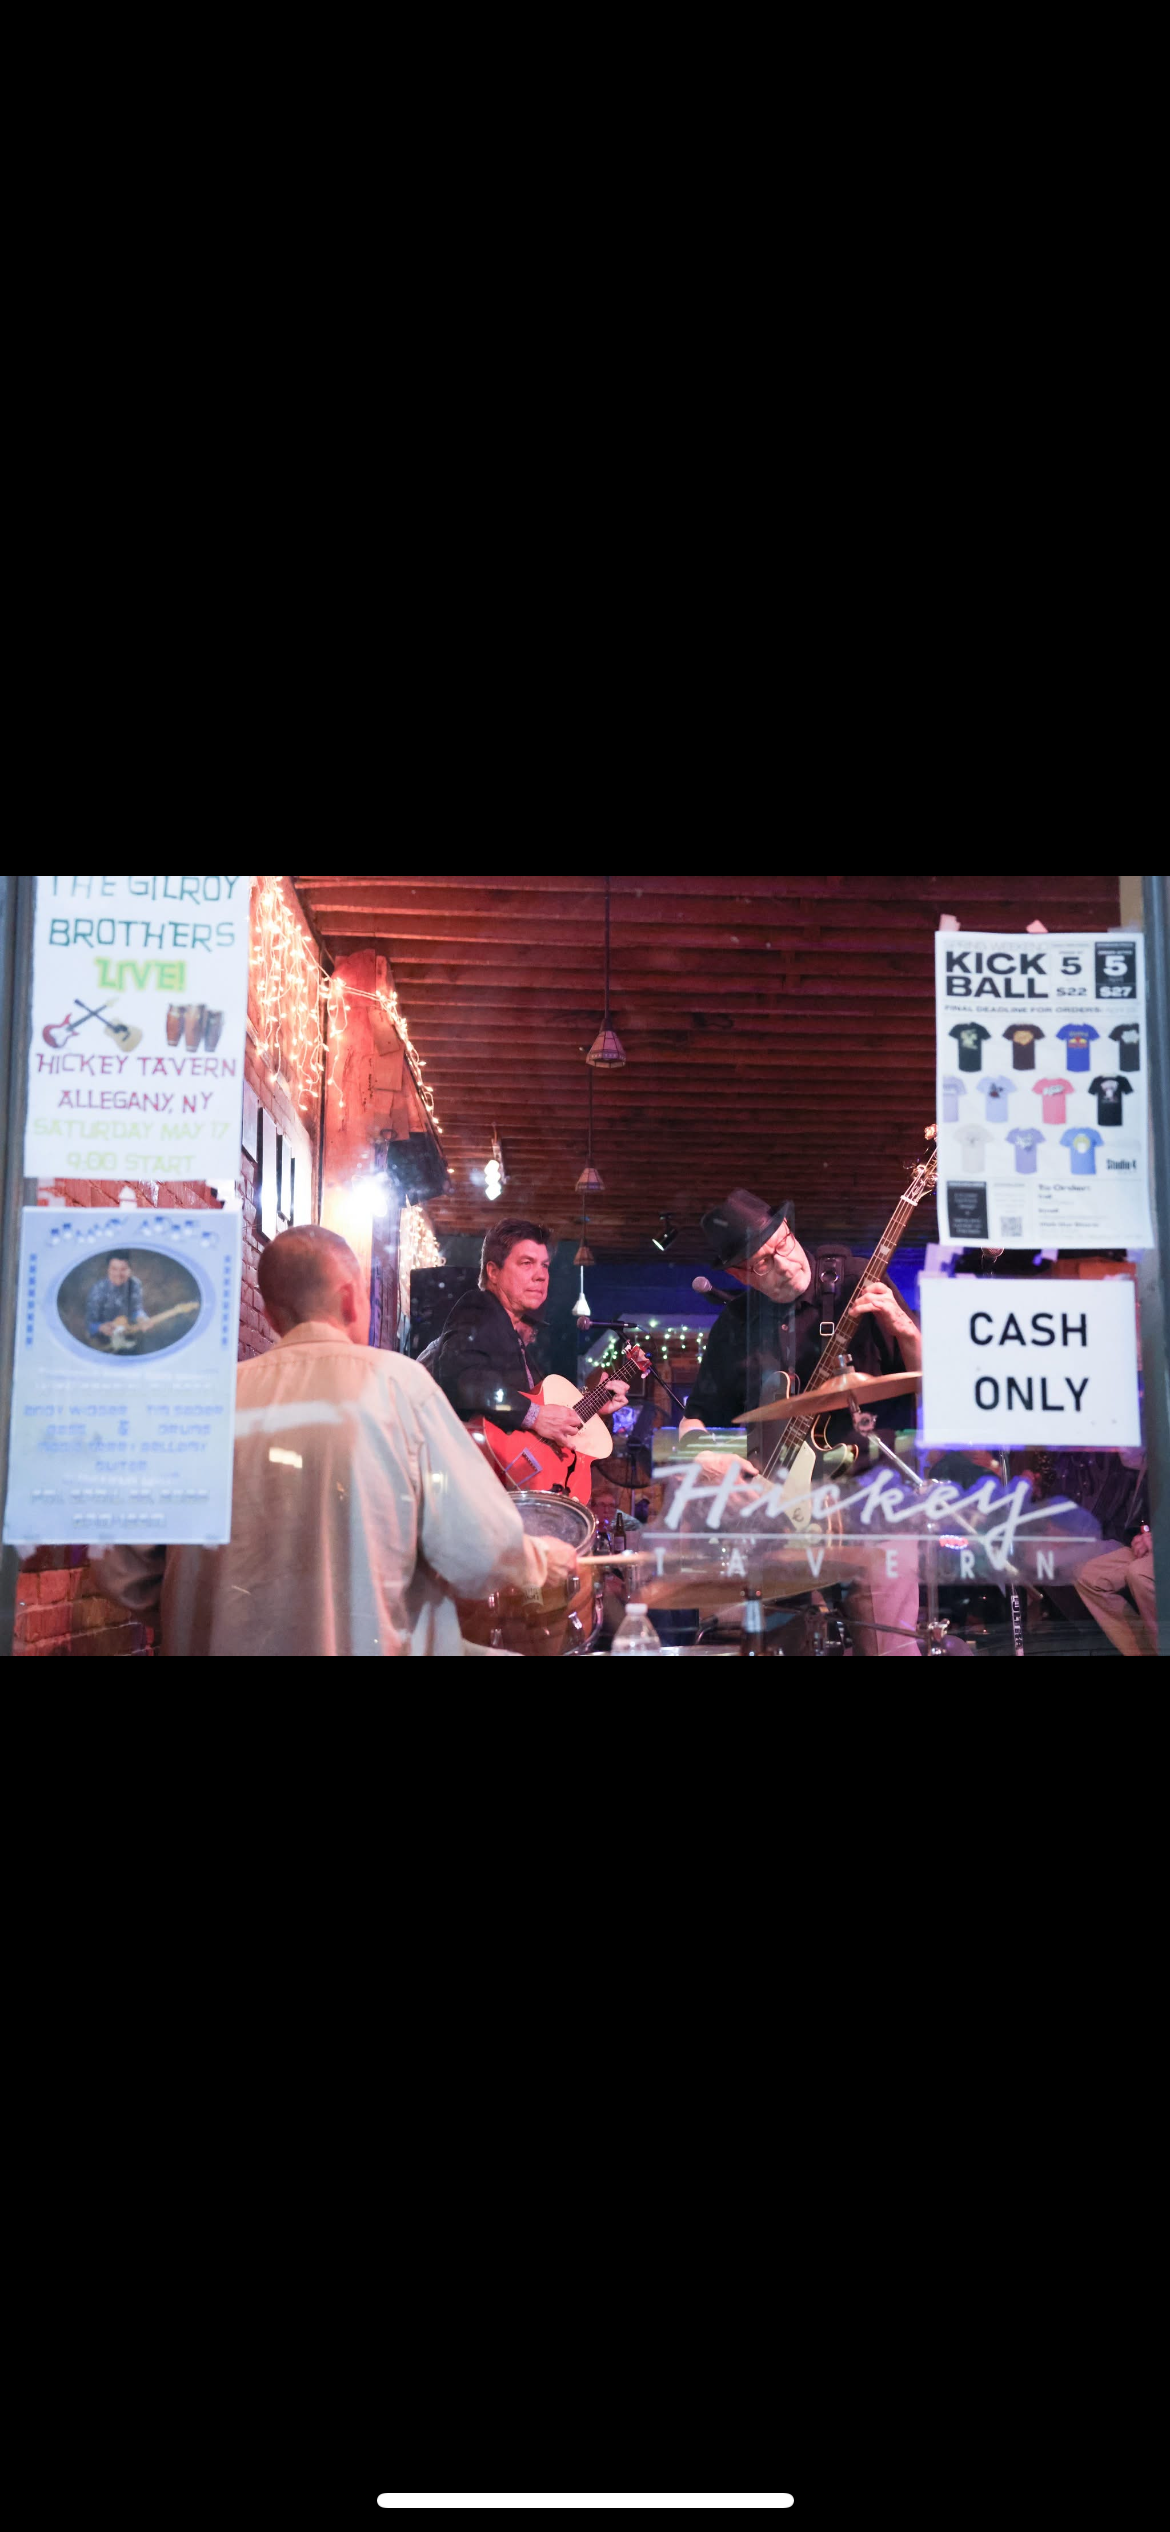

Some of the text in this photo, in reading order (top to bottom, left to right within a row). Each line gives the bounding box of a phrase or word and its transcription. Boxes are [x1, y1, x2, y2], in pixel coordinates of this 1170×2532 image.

[52, 876, 239, 905] THE GILROY
[49, 918, 234, 952] BROTHERS
[95, 957, 186, 992] LIVE!
[946, 951, 1047, 975] KICK
[1060, 956, 1082, 975] 5
[1103, 955, 1127, 976] 5
[946, 976, 1049, 998] BALL
[1099, 986, 1132, 998] $27
[976, 1005, 1027, 1013] DEADLINE
[36, 1053, 236, 1077] HICKEY TAVERN
[58, 1090, 213, 1113] ALLEGANY, NY
[34, 1119, 231, 1141] SATURDAY MAY 17
[66, 1152, 196, 1174] 9:00 START
[969, 1312, 1087, 1346] CASH
[975, 1376, 1089, 1411] ONLY
[652, 1461, 1077, 1571] Hickey
[654, 1547, 1055, 1579] TAVERN
